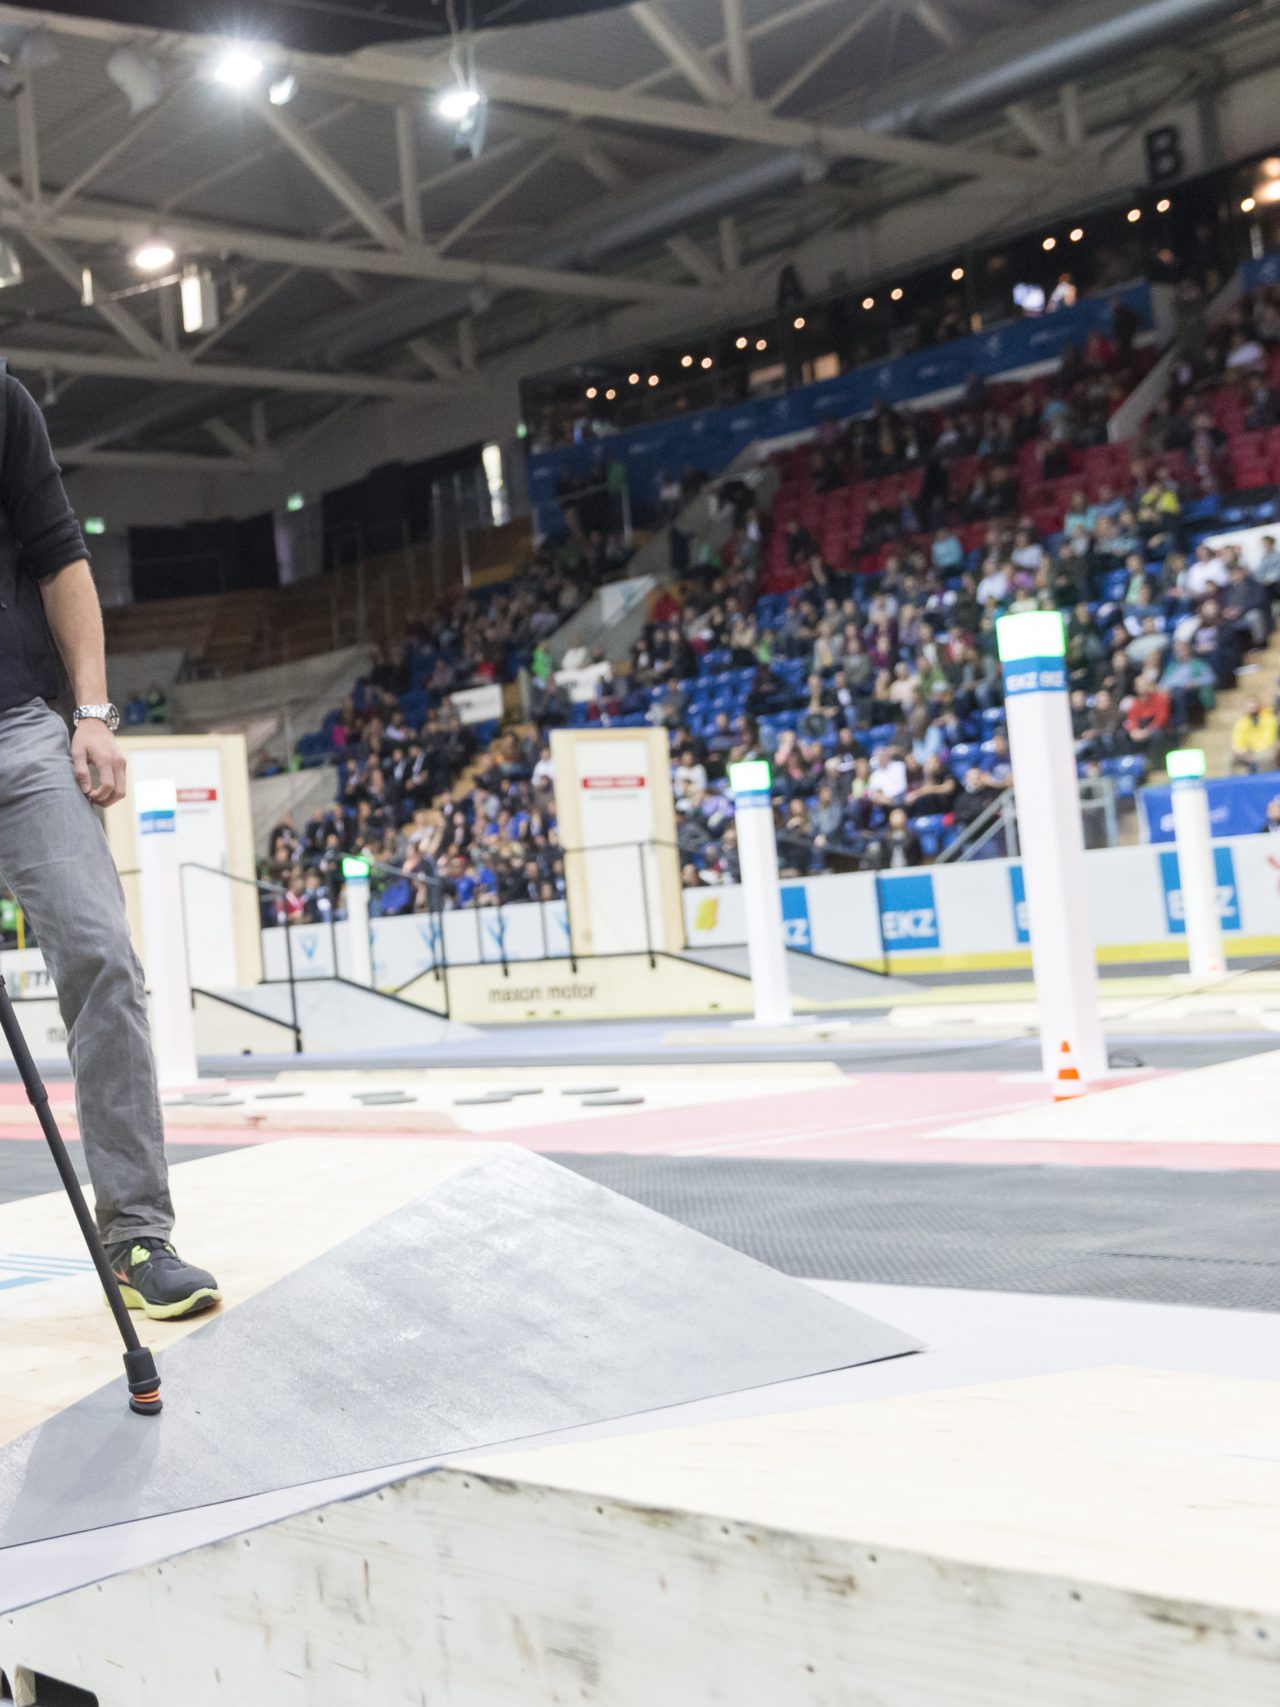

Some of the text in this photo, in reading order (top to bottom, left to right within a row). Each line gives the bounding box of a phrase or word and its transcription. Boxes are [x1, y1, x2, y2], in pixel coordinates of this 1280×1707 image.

[1167, 883, 1237, 920] EZ
[883, 907, 936, 939] EKZ
[489, 983, 596, 1003] maxon motor
